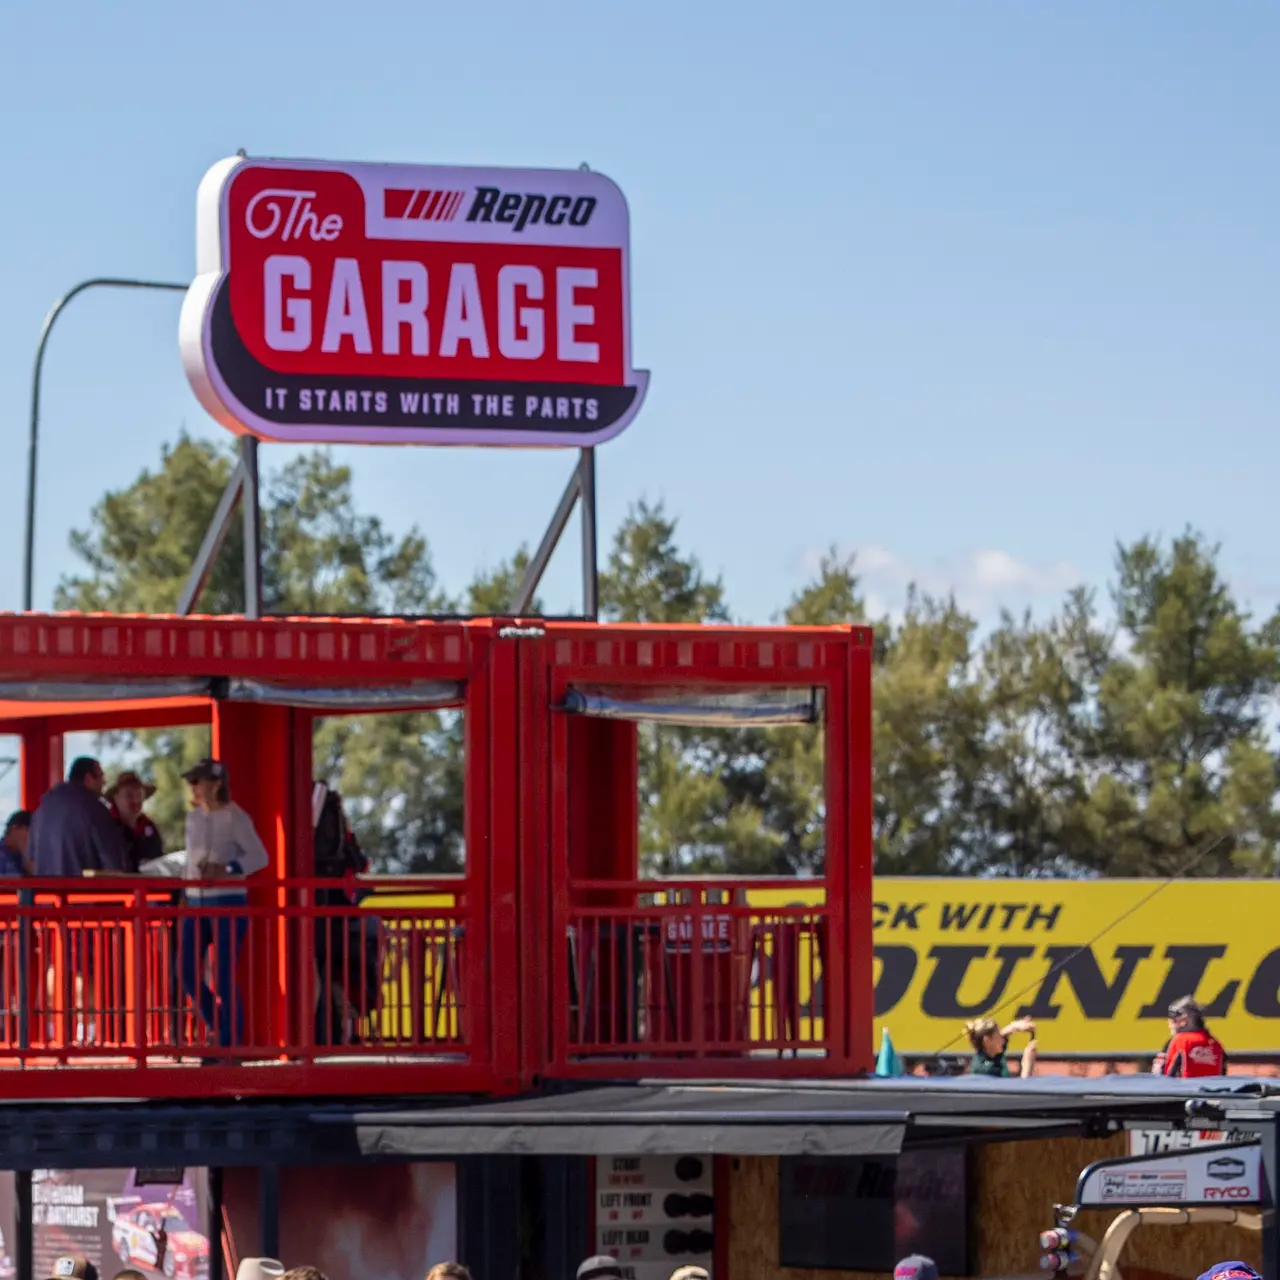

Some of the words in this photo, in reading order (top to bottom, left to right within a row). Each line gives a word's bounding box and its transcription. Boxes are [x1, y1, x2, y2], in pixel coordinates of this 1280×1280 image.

[245, 188, 343, 241] The
[466, 186, 597, 231] Repco
[263, 255, 600, 363] GARAGE
[265, 387, 287, 410] IT
[298, 388, 388, 413] STARTS
[400, 392, 460, 415] WITH
[473, 394, 514, 417] THE
[525, 397, 600, 420] PARTS
[938, 903, 1063, 931] WITH
[1204, 1186, 1250, 1199] RYCO
